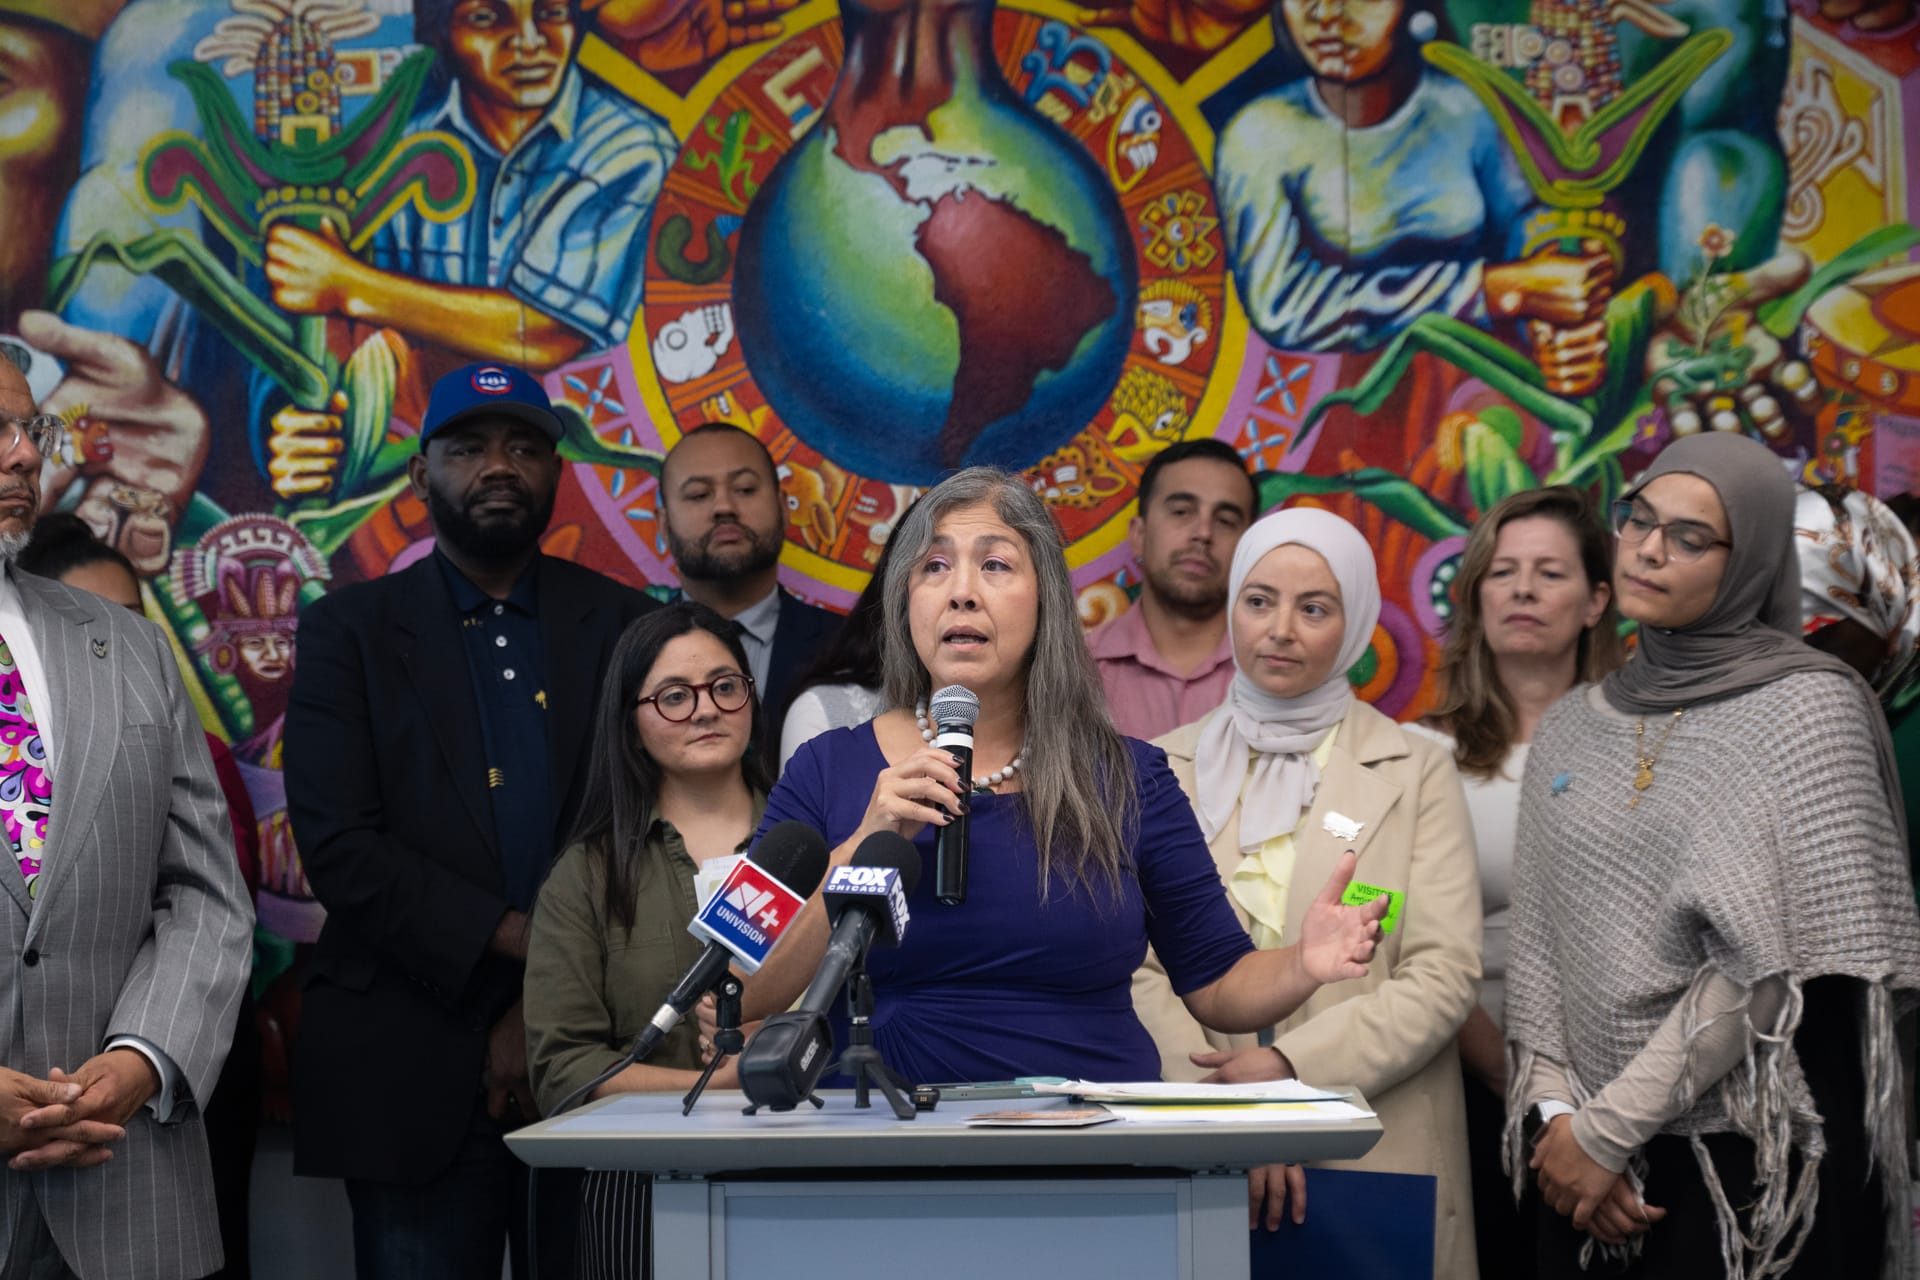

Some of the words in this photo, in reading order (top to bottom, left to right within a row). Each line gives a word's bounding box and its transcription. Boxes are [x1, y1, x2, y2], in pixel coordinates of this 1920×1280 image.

[827, 884, 886, 893] CHICAGO
[830, 866, 894, 887] FOX
[890, 874, 911, 935] FOX
[716, 905, 767, 946] UNIVISION
